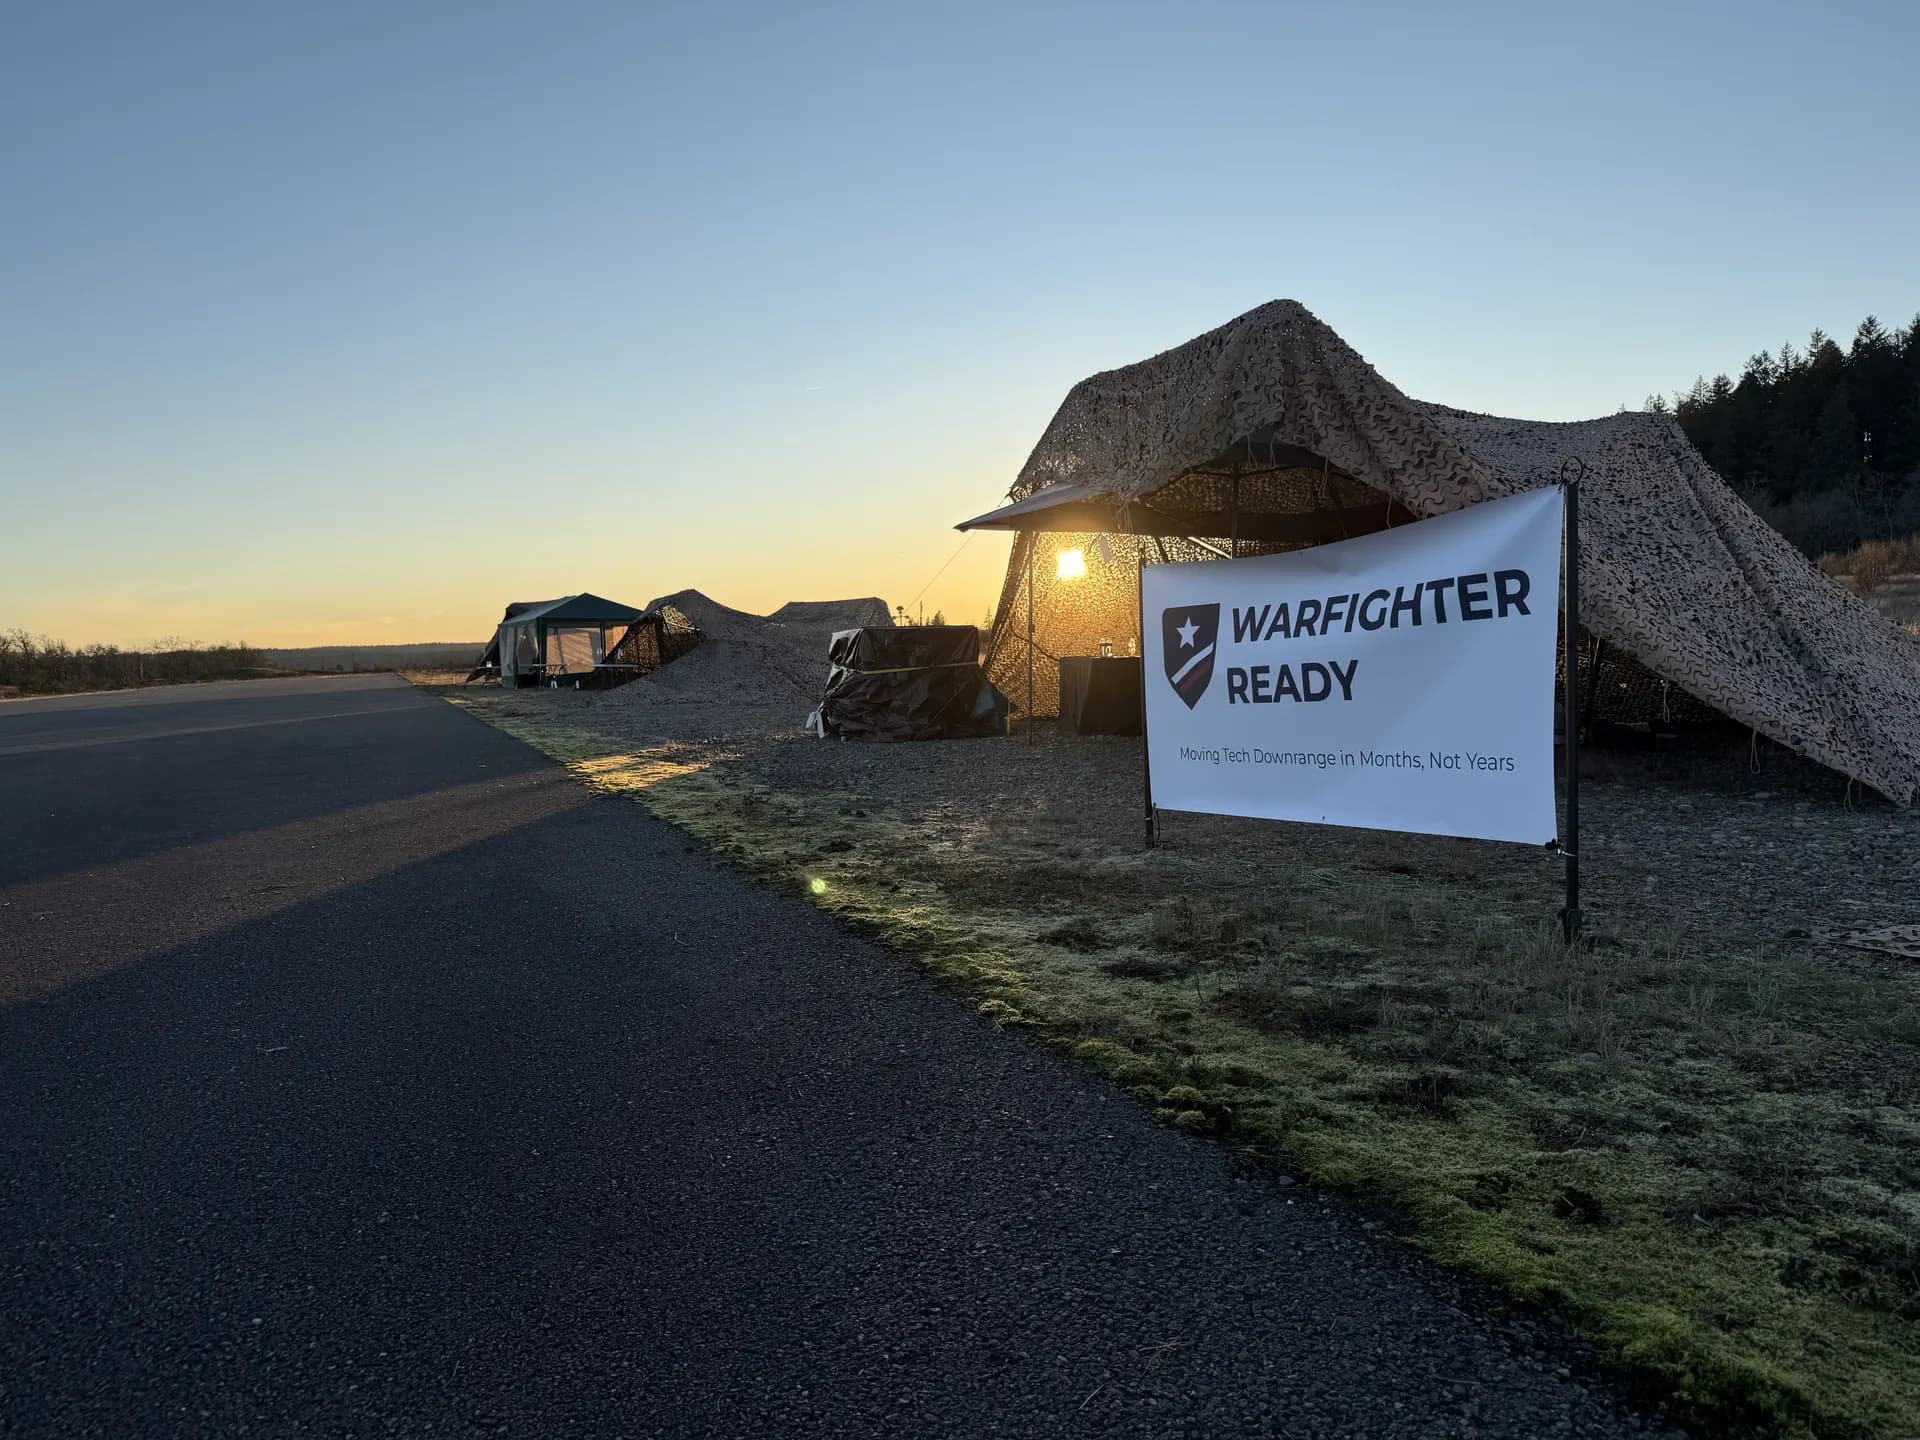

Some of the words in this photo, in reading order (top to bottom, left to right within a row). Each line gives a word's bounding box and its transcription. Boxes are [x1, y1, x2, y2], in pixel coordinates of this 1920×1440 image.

[1232, 569, 1532, 643] WARFIGHTER
[1227, 659, 1359, 704] READY
[1180, 746, 1220, 765] Moving
[1222, 747, 1251, 764] Tech
[1254, 748, 1336, 769] Downrange
[1340, 750, 1355, 768] in
[1360, 750, 1425, 772] Months,
[1430, 752, 1462, 770] Not
[1466, 752, 1515, 772] Years
